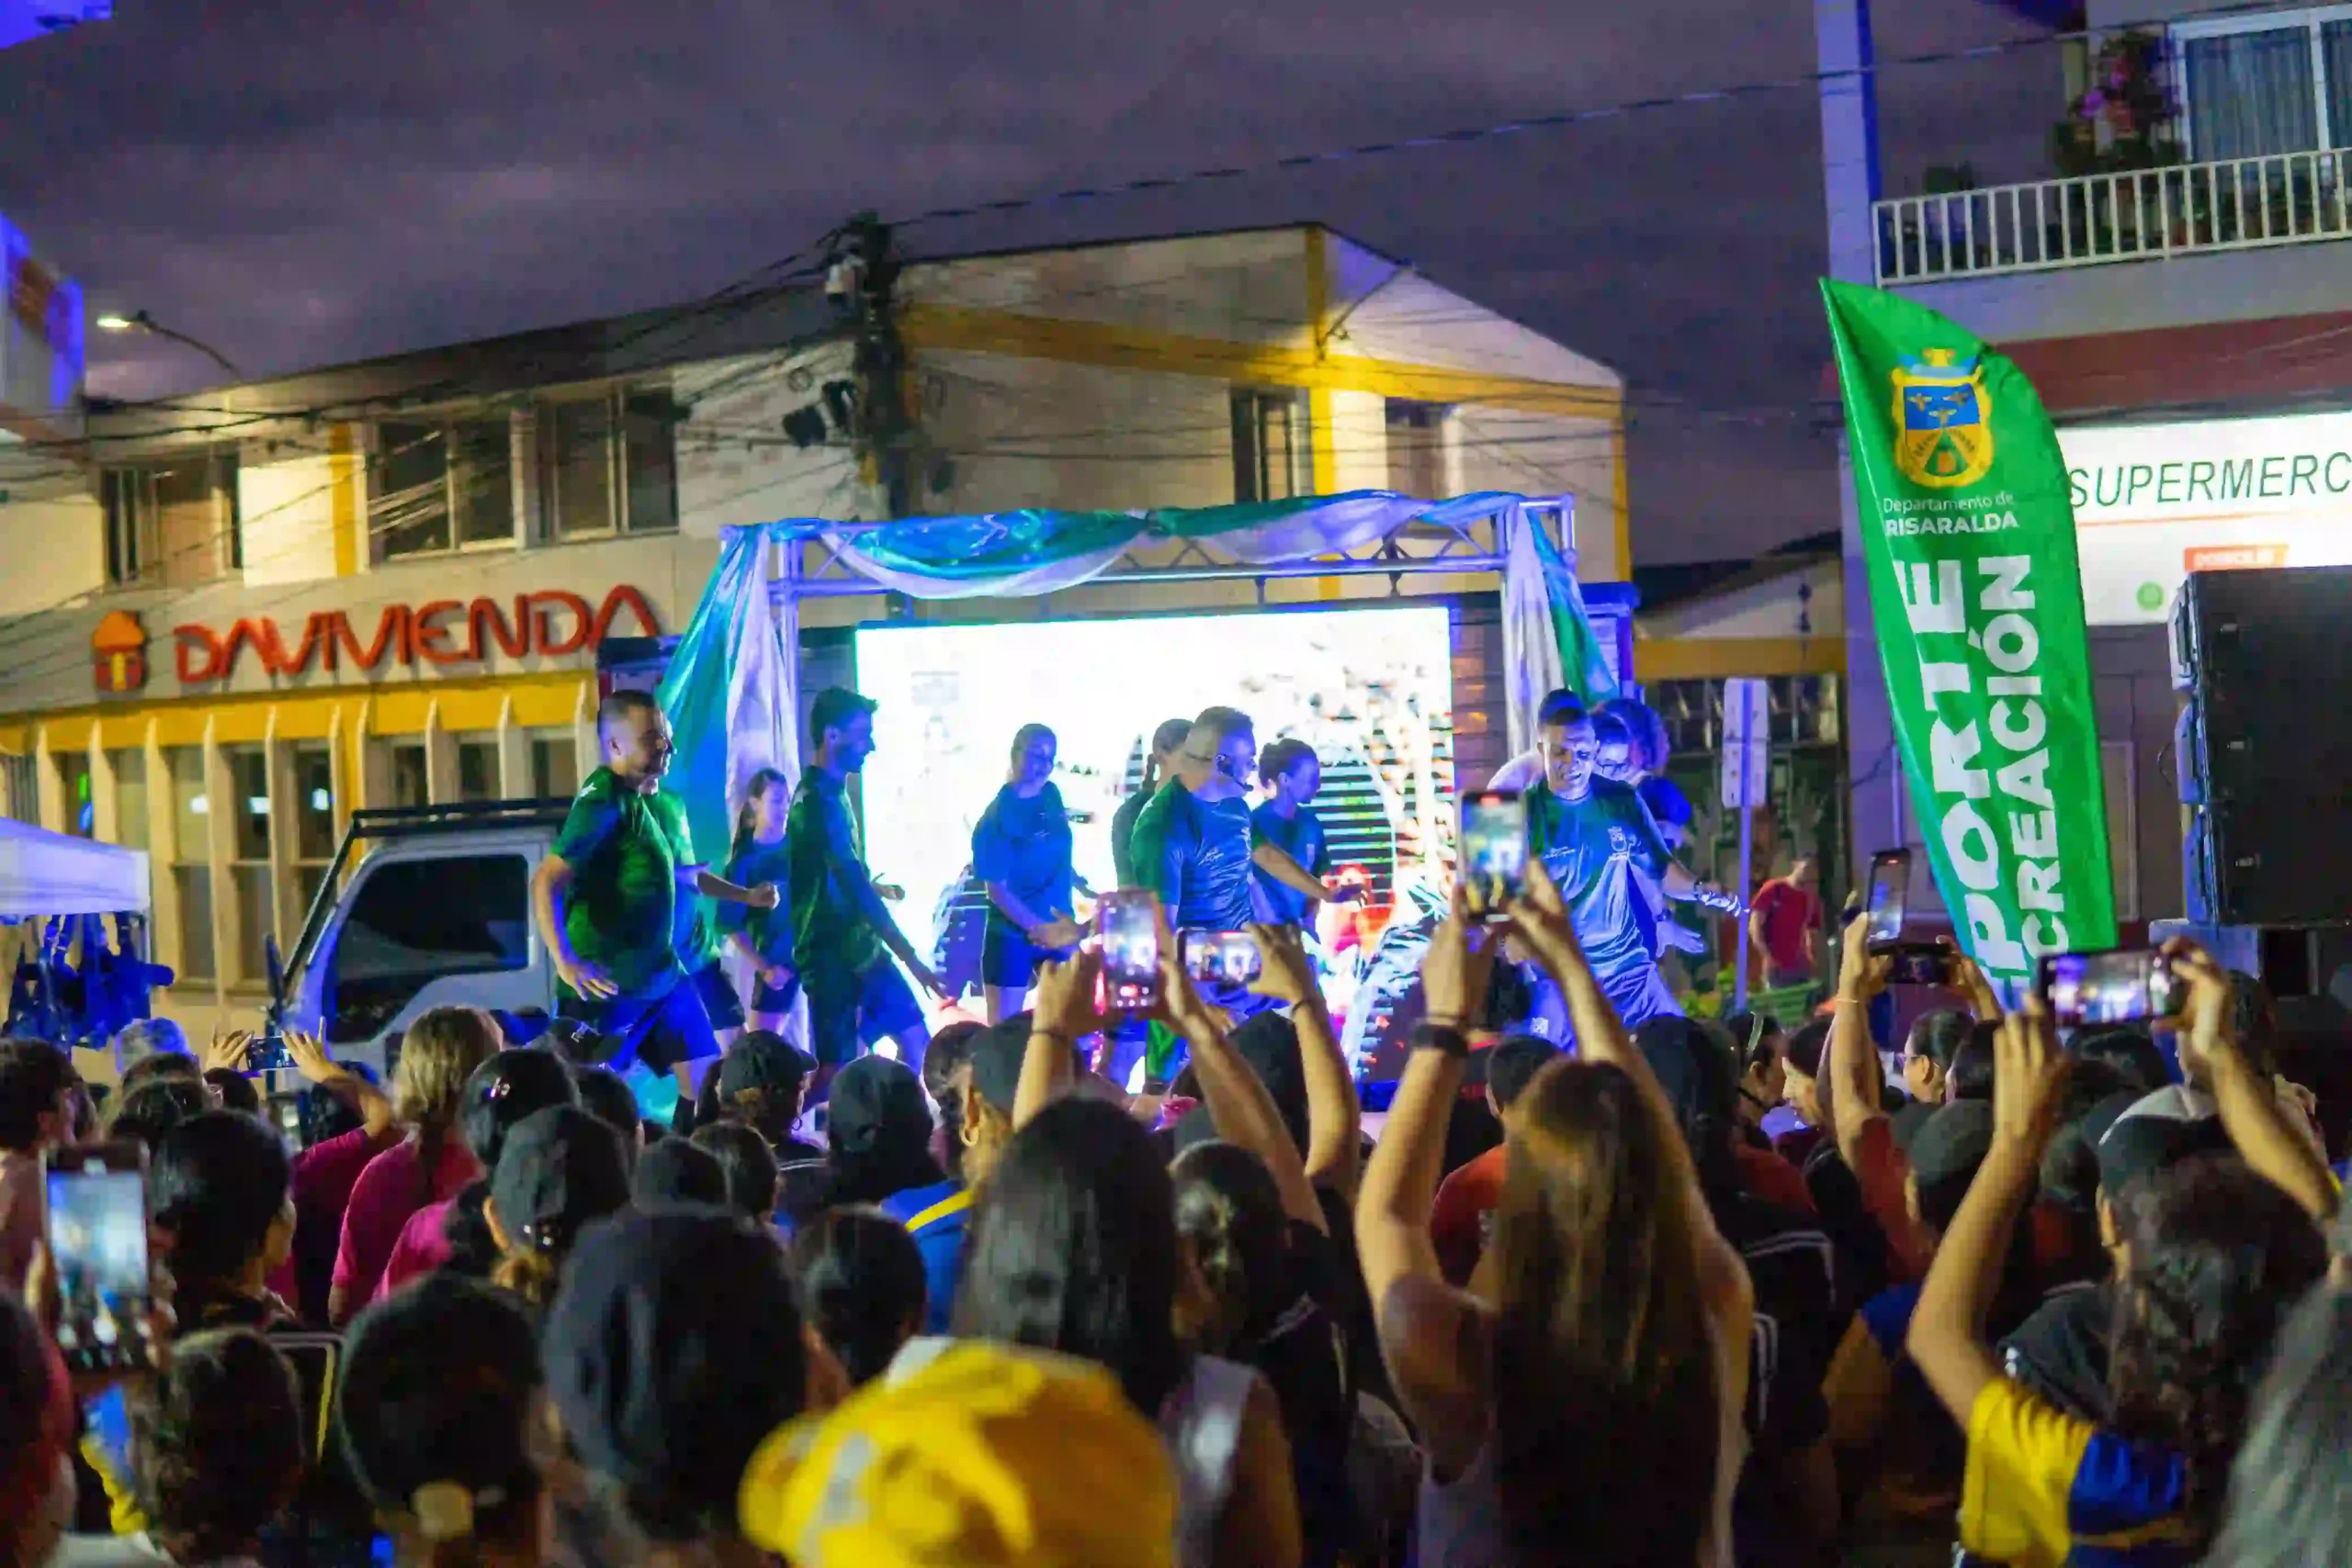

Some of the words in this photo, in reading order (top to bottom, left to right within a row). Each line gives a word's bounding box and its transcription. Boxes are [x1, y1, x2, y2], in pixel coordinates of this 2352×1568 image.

[1883, 496, 1992, 513] Departamento
[1996, 491, 2014, 505] de
[2068, 452, 2352, 508] SUPERMERC
[1885, 511, 2019, 536] RISARALDA
[174, 584, 660, 682] DAVIVIENDA
[1967, 555, 2068, 959] CREACIÓN
